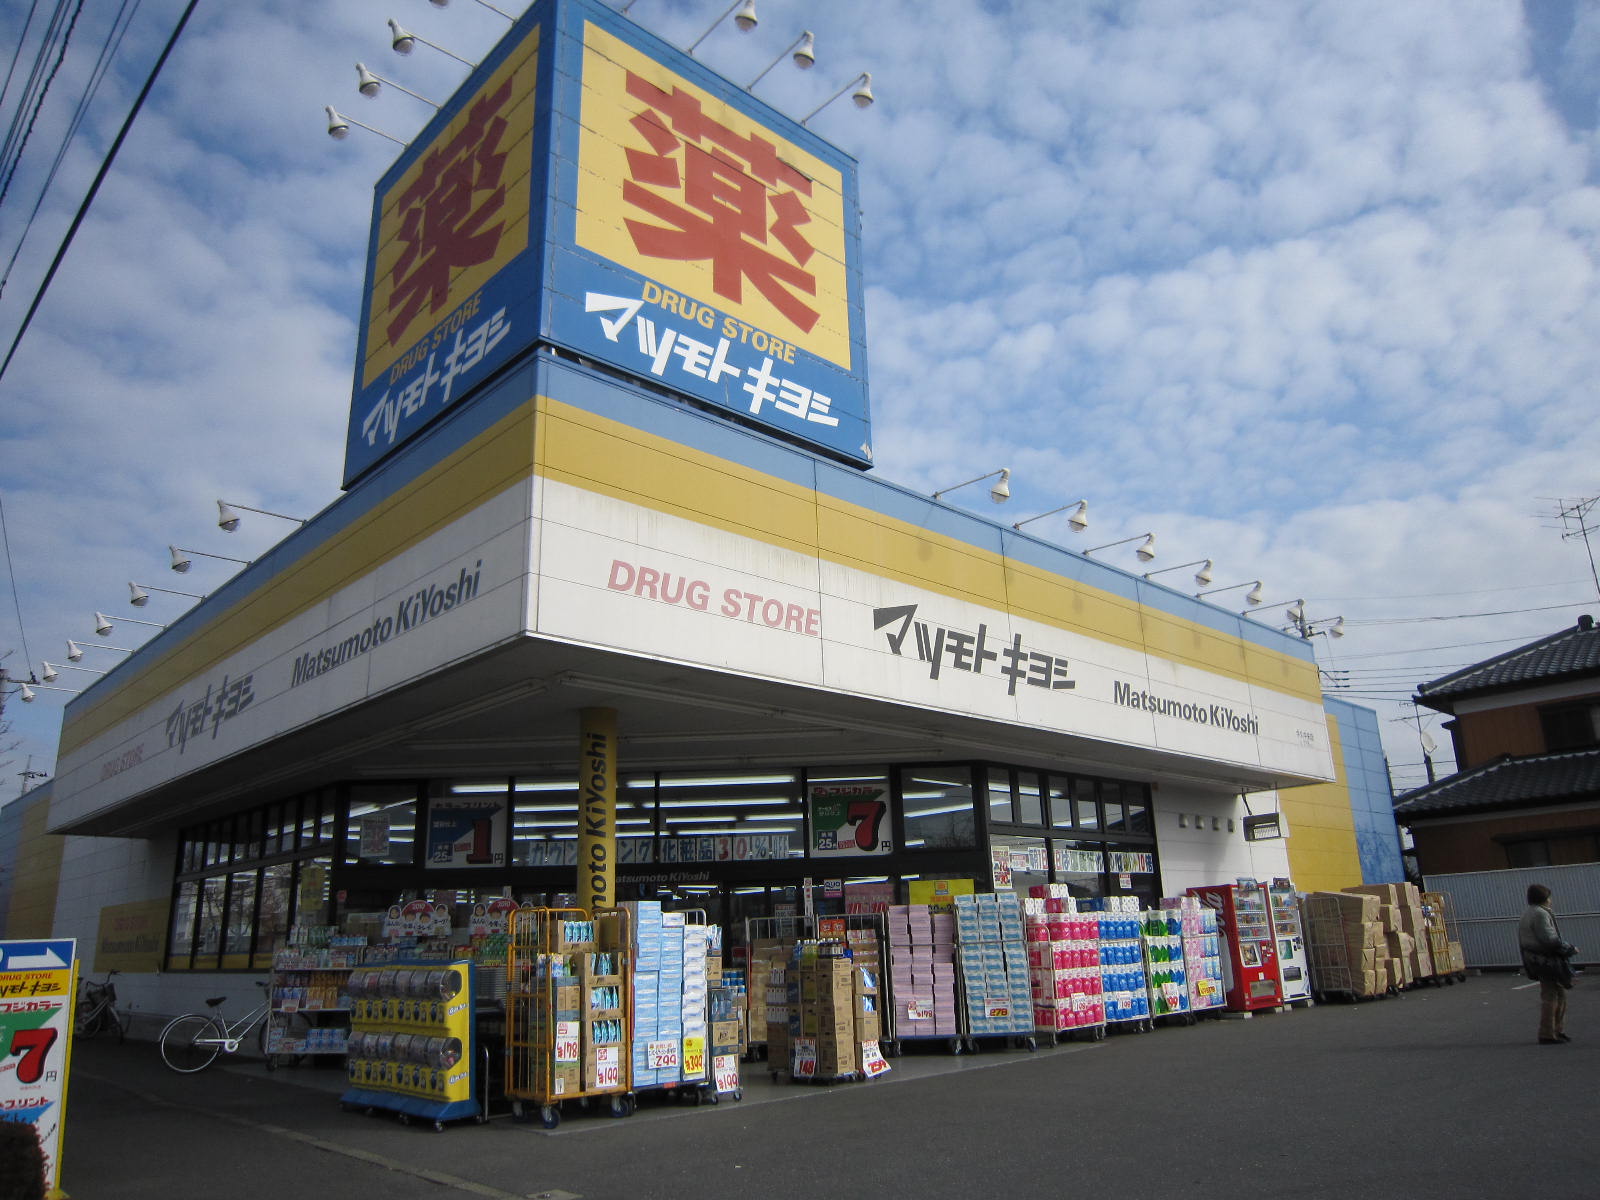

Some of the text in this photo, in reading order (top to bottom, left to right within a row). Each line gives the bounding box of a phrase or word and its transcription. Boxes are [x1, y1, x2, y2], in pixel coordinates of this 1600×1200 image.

[387, 78, 513, 346] 薬
[622, 70, 821, 334] 薬
[390, 291, 482, 385] DRUG STORE
[584, 292, 839, 427] マツモトキヨシ
[642, 281, 796, 365] DRUG STORE
[291, 559, 483, 688] Matsumoto KiYoshi
[606, 558, 821, 636] DRUG STORE
[873, 603, 1076, 696] マツモトキヨシ
[1113, 680, 1259, 736] Matsumoto KiYoshi
[586, 732, 607, 838] KiYoshi
[848, 800, 887, 851] 7
[467, 818, 494, 864] 1
[615, 873, 668, 883] atsumoto
[25, 971, 53, 980] STORE
[10, 1027, 58, 1084] 7
[45, 1071, 57, 1082] 円
